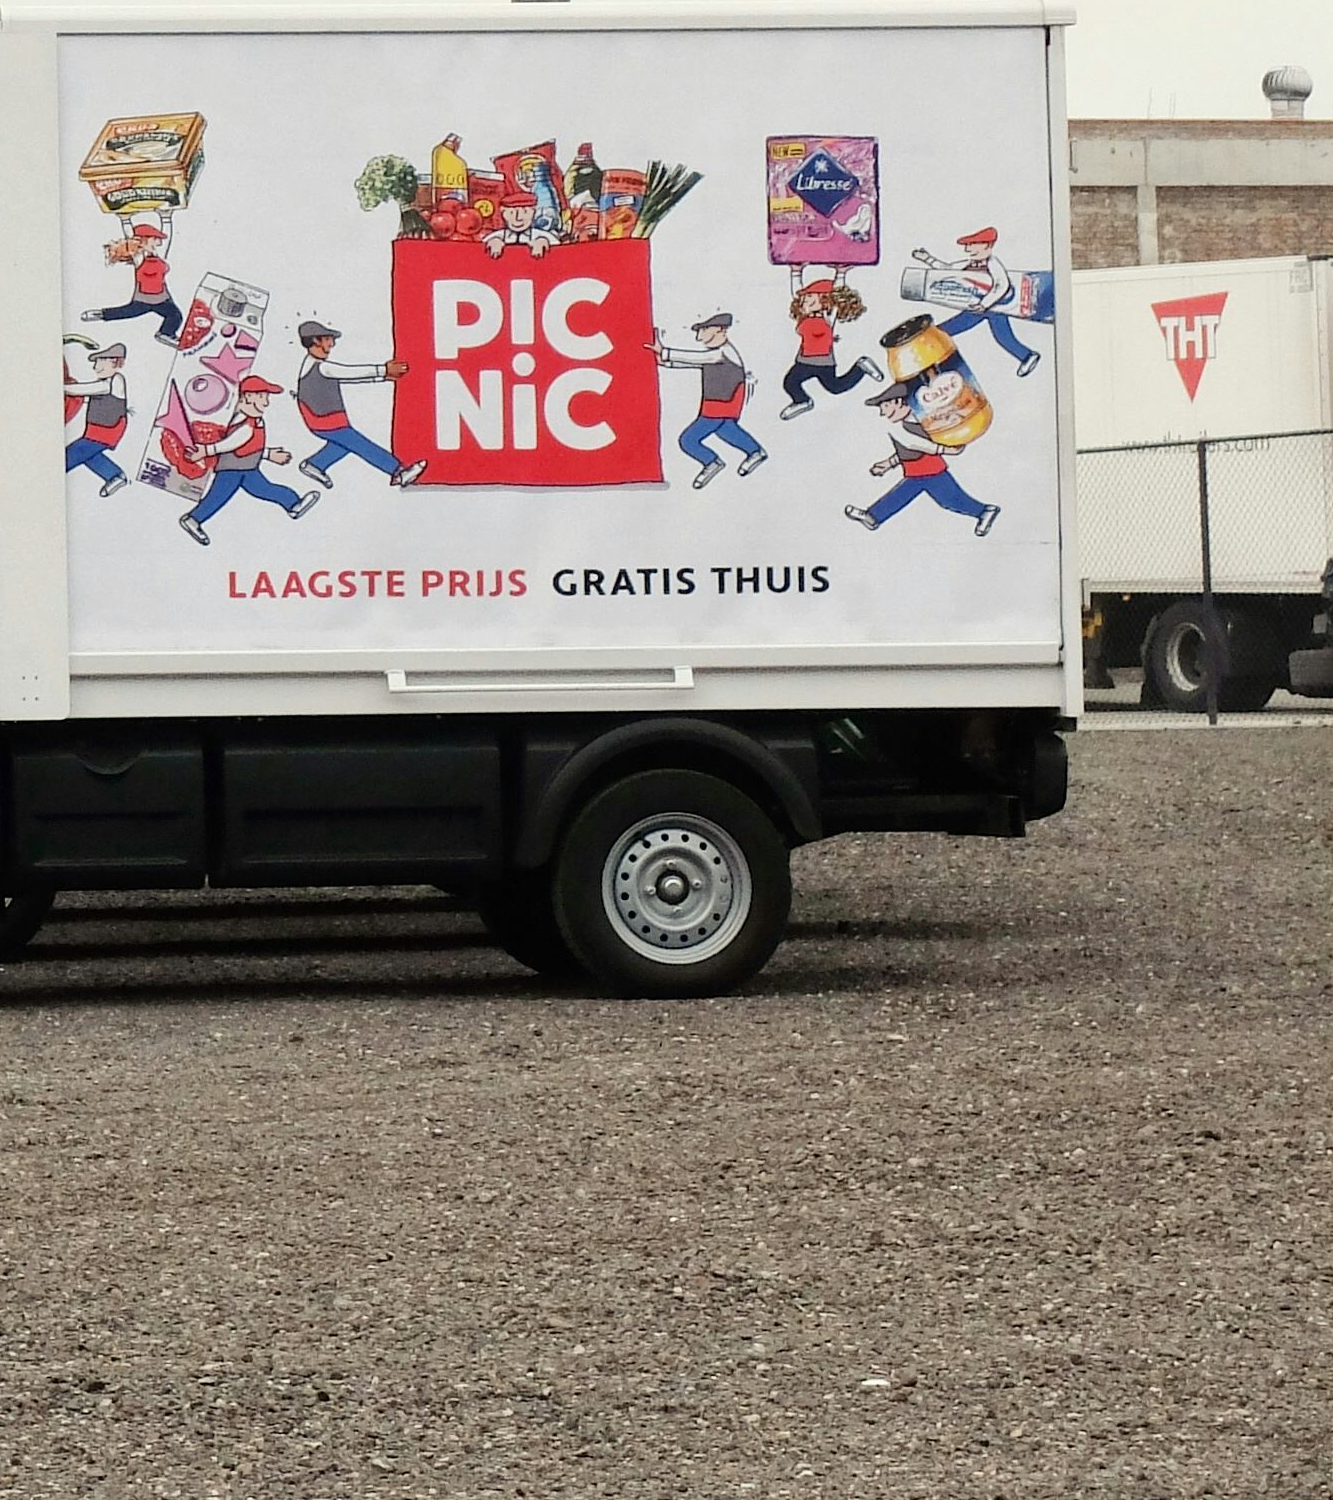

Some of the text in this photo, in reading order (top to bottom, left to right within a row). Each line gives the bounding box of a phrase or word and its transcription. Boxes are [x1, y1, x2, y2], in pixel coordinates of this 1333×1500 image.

[796, 173, 852, 191] Libresse
[432, 277, 614, 361] PIC
[1160, 315, 1221, 361] THT
[228, 565, 830, 599] LAAGSTE PRIJS GRATIS THUIS
